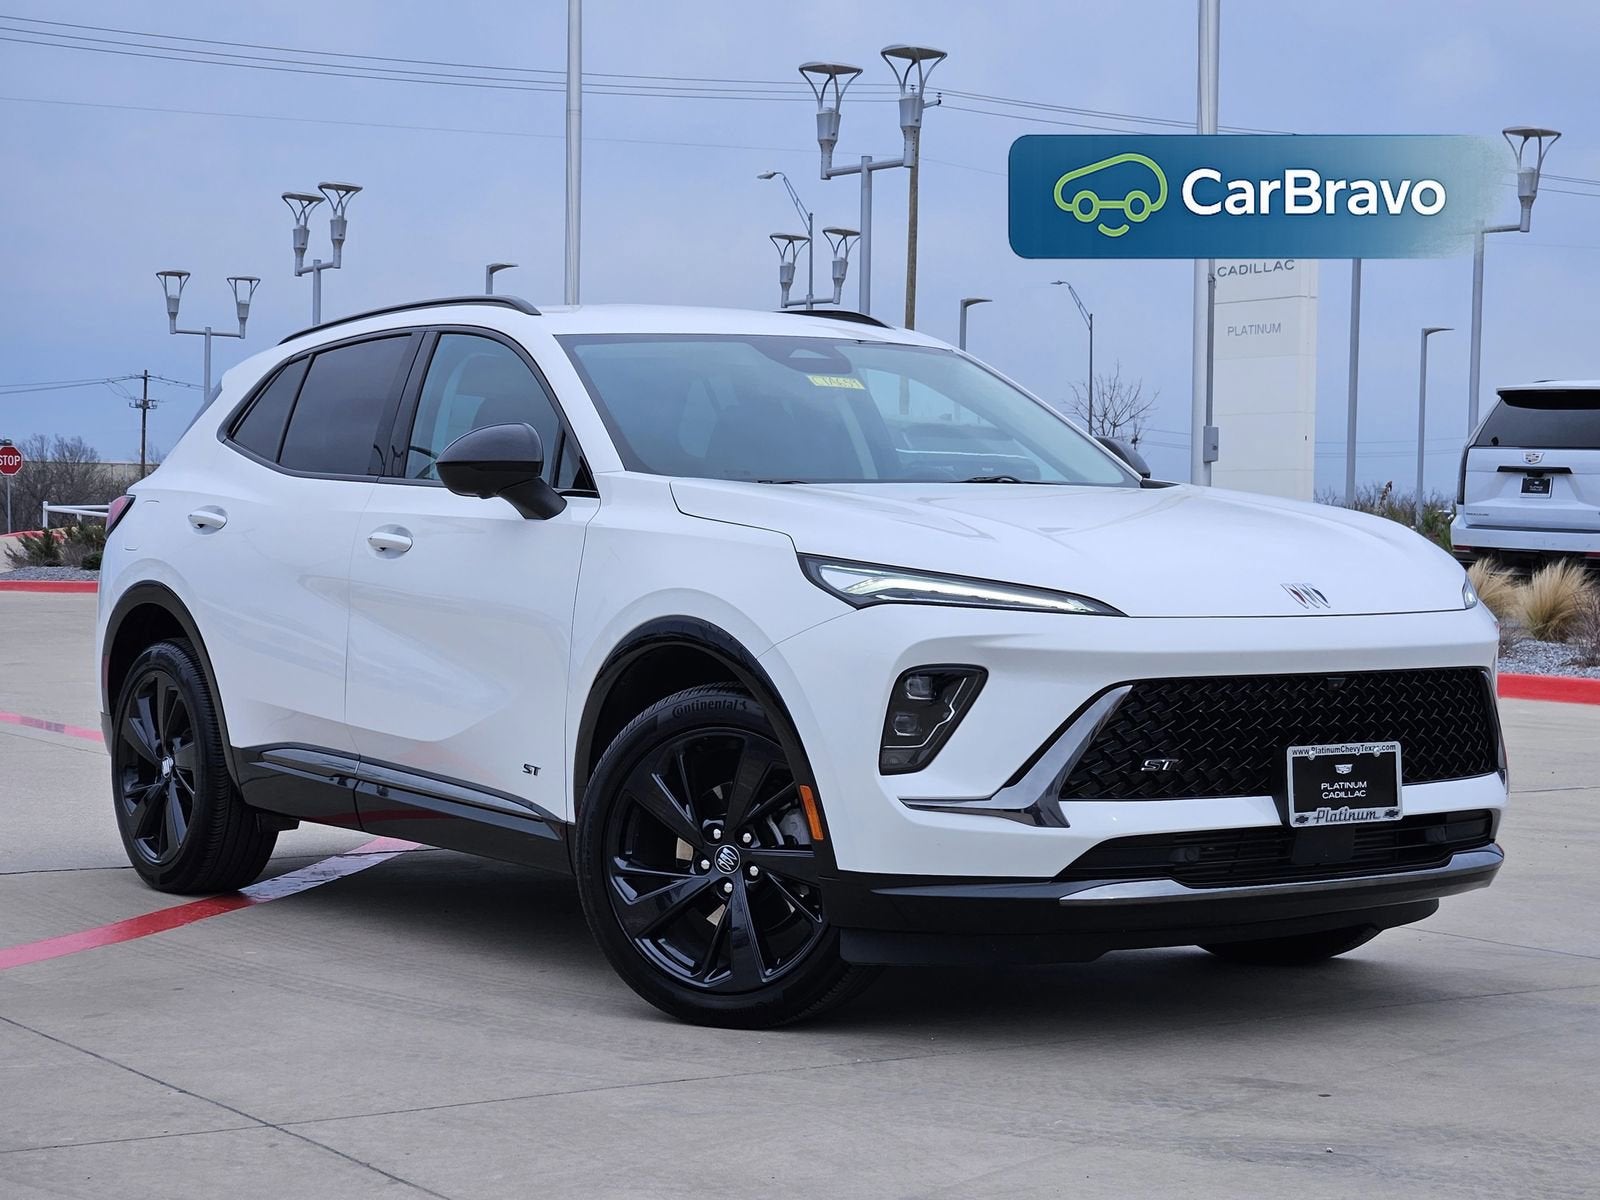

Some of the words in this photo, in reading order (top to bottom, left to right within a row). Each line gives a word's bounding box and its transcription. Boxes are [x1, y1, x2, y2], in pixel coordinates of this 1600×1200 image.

[1217, 259, 1295, 277] CADILLAC
[1227, 323, 1281, 336] PLATINUM
[672, 699, 737, 718] Continental
[1292, 744, 1396, 755] wwwPlatinumChevyTexa.com
[522, 763, 542, 776] ST
[1140, 759, 1179, 771] ST
[1321, 781, 1367, 790] PLATINUM
[1322, 790, 1366, 799] CADILLAC
[1313, 808, 1379, 824] Platinum
